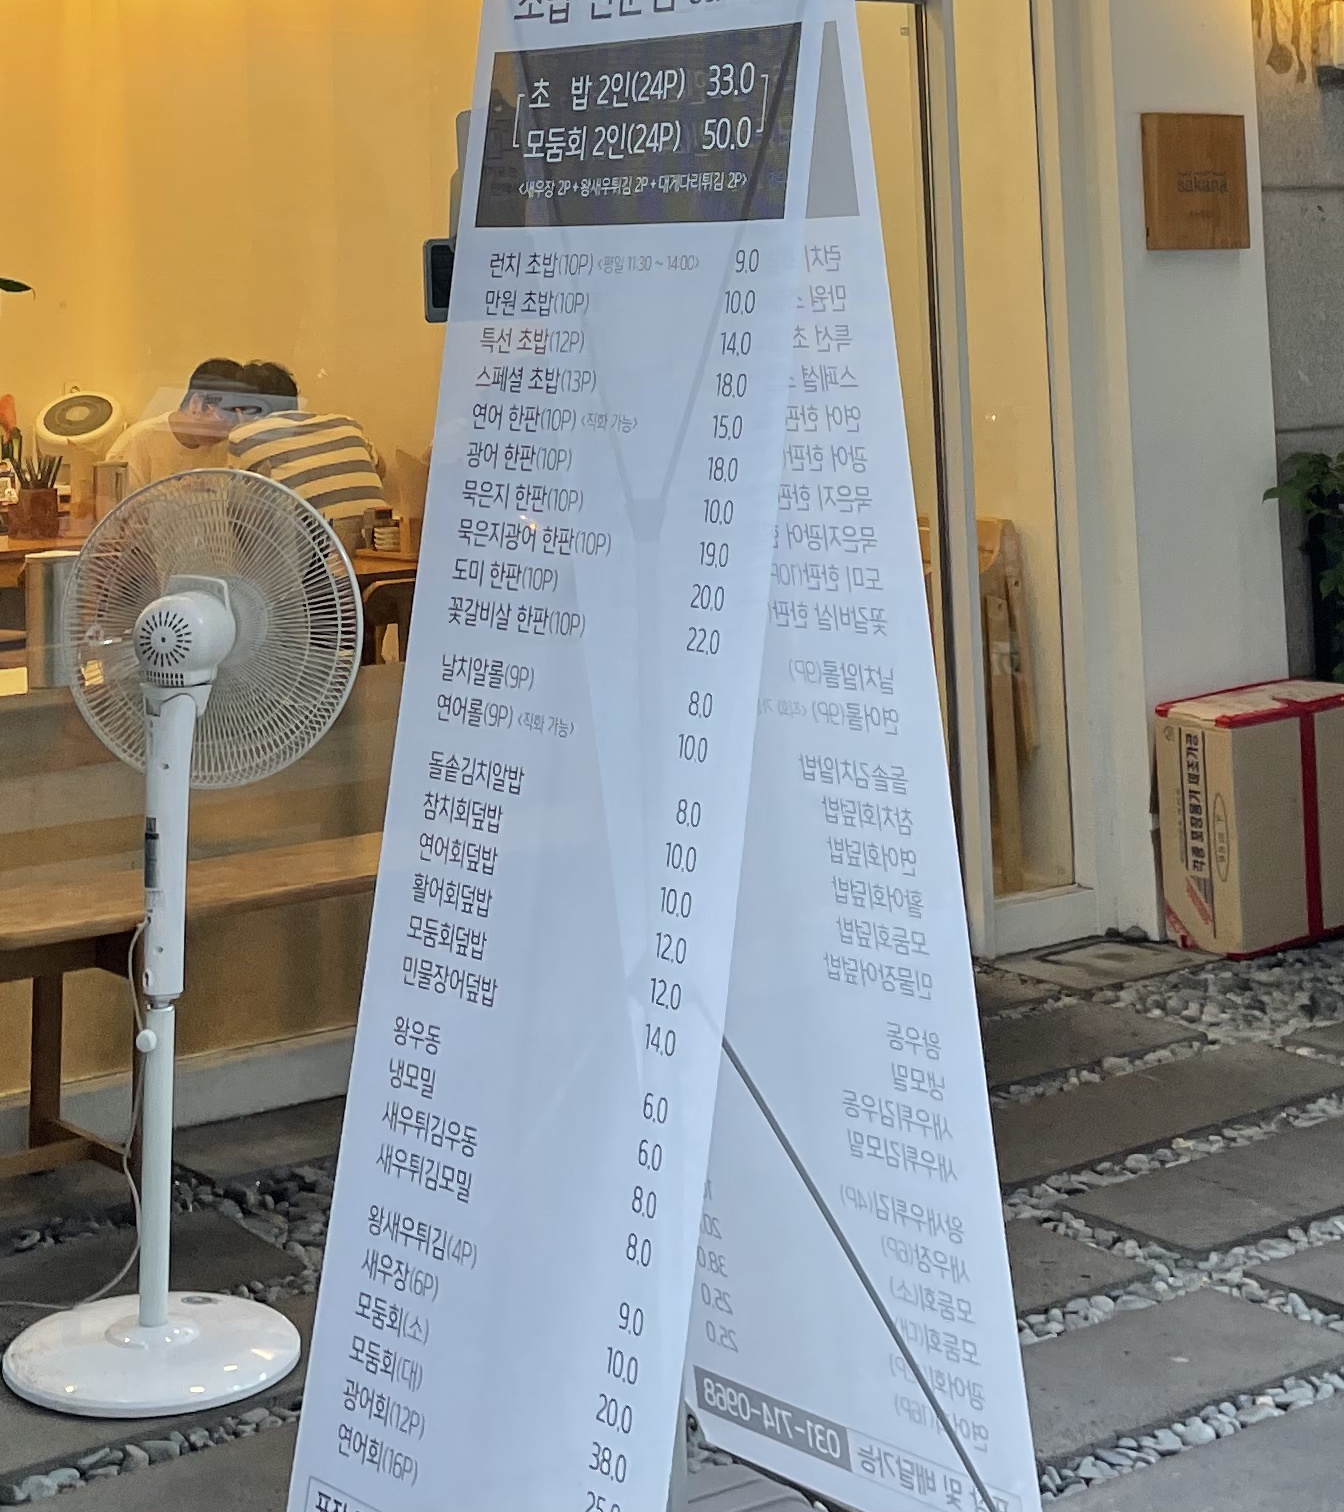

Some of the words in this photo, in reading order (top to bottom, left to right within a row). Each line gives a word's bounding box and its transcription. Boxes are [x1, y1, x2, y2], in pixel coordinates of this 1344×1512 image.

[596, 67, 686, 107] 2인(24P)
[707, 62, 754, 98] 33.0
[522, 127, 587, 162] 모둠회
[592, 120, 682, 161] 2인(24P)
[702, 117, 752, 150] 50.0
[490, 252, 521, 279] 런치
[526, 249, 594, 280] 초밥(10P)
[735, 249, 760, 274] 9.0
[485, 290, 516, 316] 만원
[521, 290, 590, 316] 초밥(10P)
[724, 289, 755, 315] 10.0
[479, 328, 511, 355] 특선
[517, 328, 585, 355] 초밥(12P)
[720, 331, 752, 356] 14.0
[475, 365, 523, 394] 스페셜
[528, 367, 597, 394] 초밥(13P)
[715, 372, 747, 399] 18.0
[472, 404, 502, 431] 연어
[508, 406, 576, 433] 한판(10P)
[712, 414, 743, 441] 15.0
[466, 442, 498, 470] 광어
[504, 444, 572, 472] 한판(10P)
[707, 456, 738, 483] 18.0
[462, 481, 510, 510] 묵은지
[515, 483, 584, 513] 한판(10P)
[703, 499, 734, 526] 10.0
[458, 519, 537, 553] 묵은지광어
[542, 526, 611, 557] 한판(10P)
[699, 541, 729, 568] 19.0
[452, 558, 485, 587] 도미
[490, 561, 558, 592] 한판(10P)
[690, 584, 725, 611] 20.0
[447, 597, 513, 632] 꽃갈비살
[516, 605, 585, 638] 한판(10P)
[686, 626, 720, 656] 22.0
[441, 654, 535, 691] 날치알롤(9P)
[688, 690, 713, 719] 8.0
[437, 694, 514, 729] 연어롤(9P)
[678, 733, 708, 764] 10.0
[428, 750, 525, 795] 돌솥김치알밥
[675, 798, 702, 828] 8.0
[422, 792, 504, 833] 참치회덮밥
[665, 841, 697, 873] 10.0
[418, 833, 498, 876] 연어회덮밥
[660, 886, 692, 919] 10.0
[412, 872, 493, 918] 활어회덮밥
[656, 932, 687, 965] 12.0
[406, 915, 488, 960] 모둠회덮밥
[650, 977, 682, 1012] 12.0
[402, 956, 499, 1008] 민물장어덮밥
[644, 1023, 677, 1058] 14.0
[392, 1016, 443, 1056] 왕우동
[642, 1091, 669, 1125] 6.0
[388, 1057, 437, 1099] 냉모밀
[637, 1139, 663, 1172] 6.0
[381, 1100, 478, 1159] 새우튀김우동
[631, 1185, 657, 1220] 8.0
[375, 1142, 473, 1203] 새우튀김모밀
[626, 1233, 652, 1268] 8.0
[367, 1204, 478, 1270] 왕새우튀김(4P)
[618, 1302, 644, 1337] 9.0
[360, 1248, 440, 1301] 새우장(6P)
[606, 1346, 639, 1386] 10.0
[354, 1291, 430, 1346] 모둠회(소)
[595, 1394, 633, 1434] 20.0
[342, 1377, 426, 1440] 광어회(12P)
[585, 1491, 621, 1512] 25.0
[348, 1335, 424, 1390] 모둠회(대)
[588, 1441, 628, 1484] 38.0
[337, 1423, 418, 1487] 연어회(16P)
